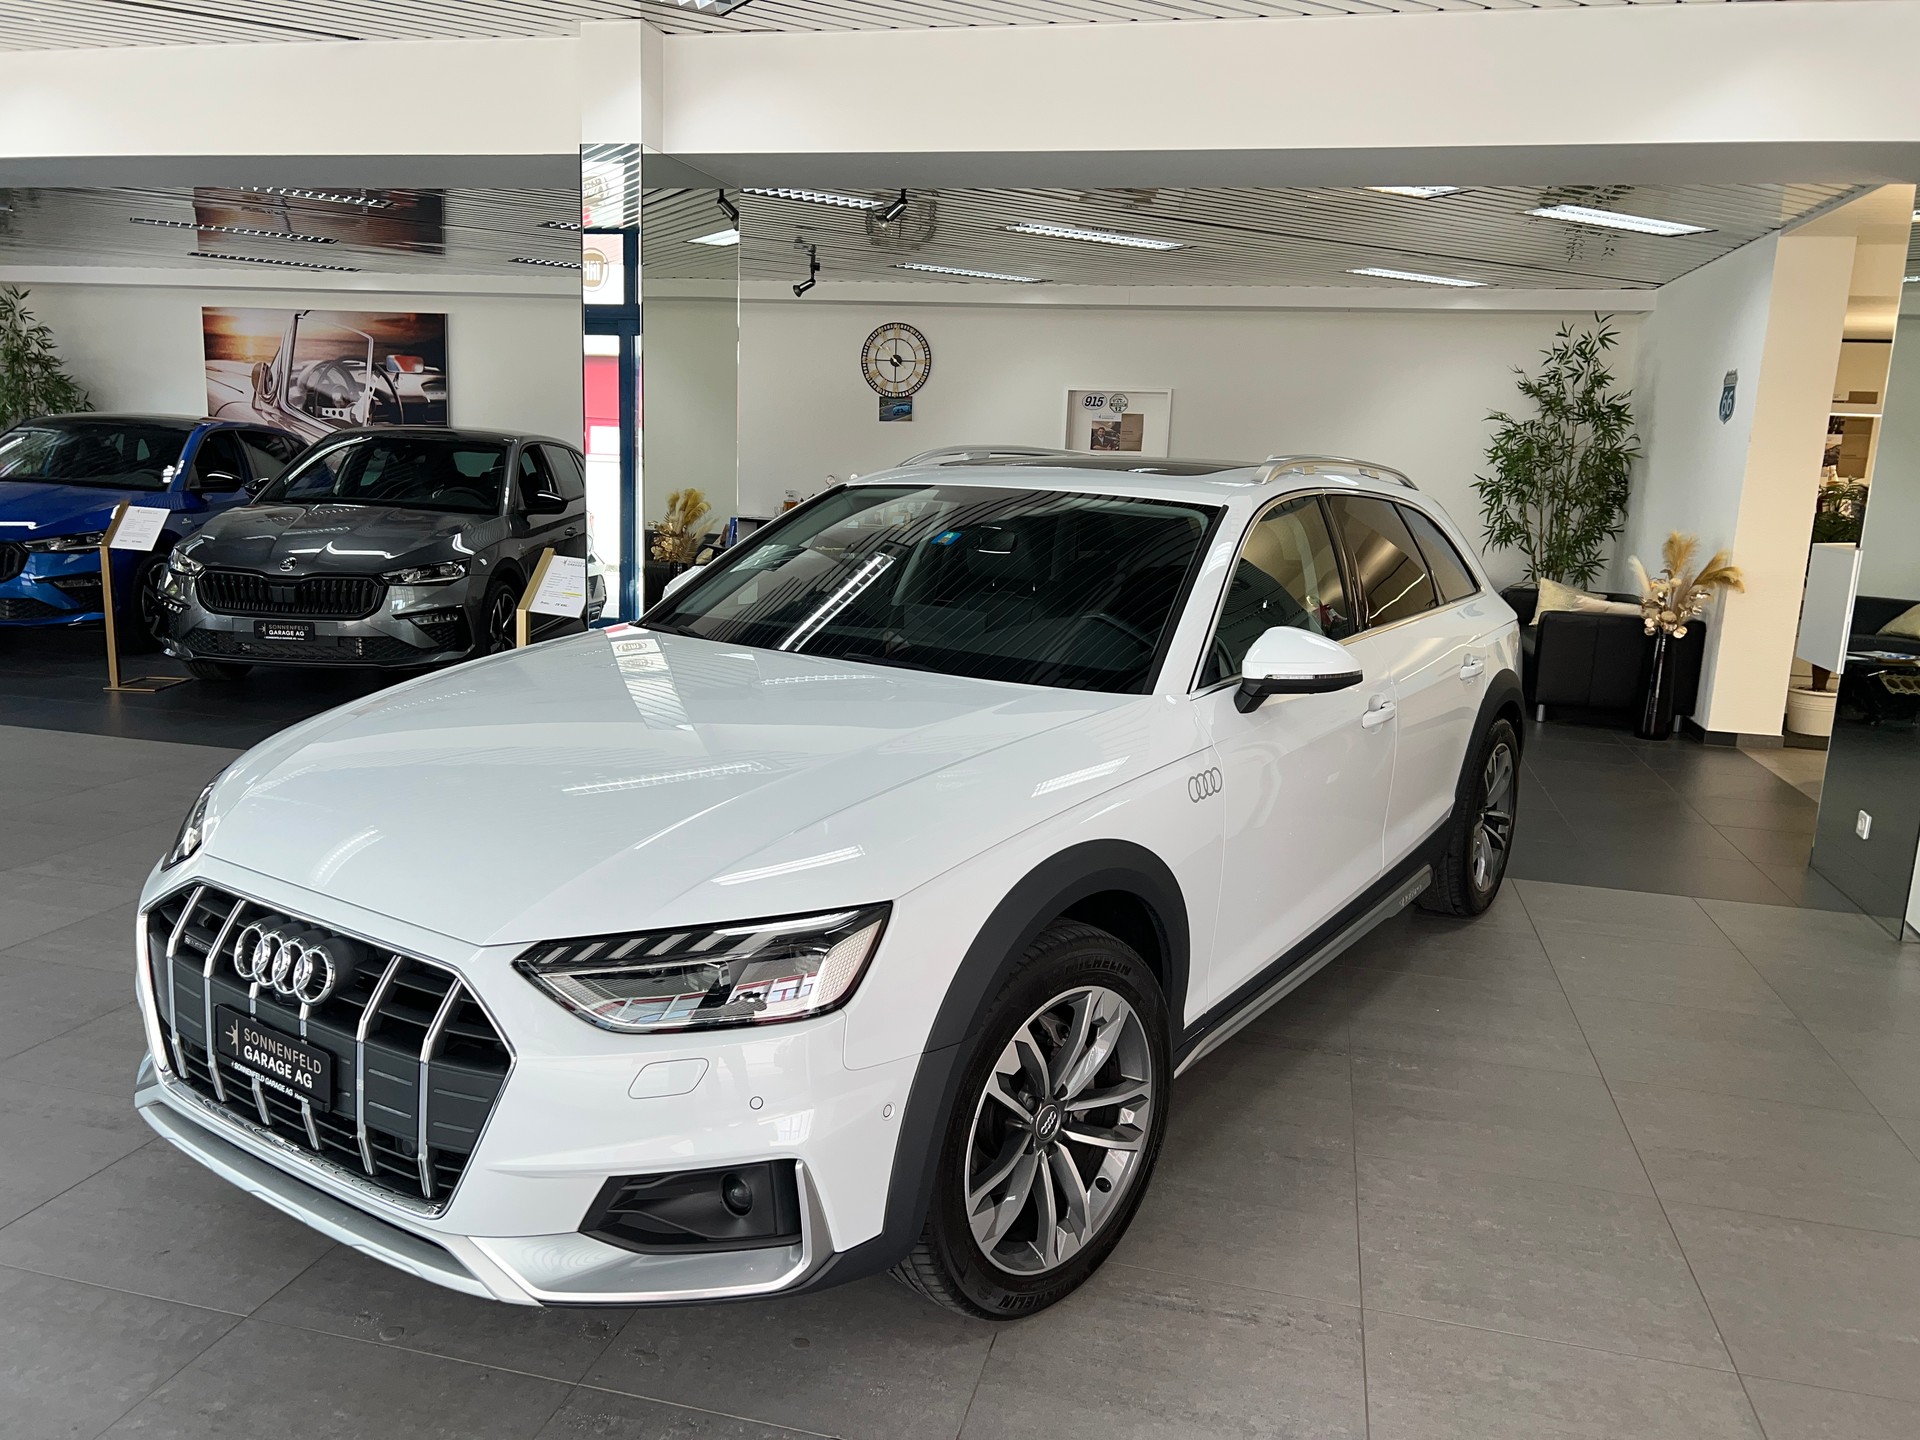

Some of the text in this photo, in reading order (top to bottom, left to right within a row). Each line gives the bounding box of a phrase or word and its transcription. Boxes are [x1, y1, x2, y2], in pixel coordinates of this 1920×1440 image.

[1084, 396, 1104, 407] 915
[1721, 390, 1733, 416] 66
[244, 1028, 322, 1074] SONNENFELD
[244, 1045, 313, 1088] GARAGE AG
